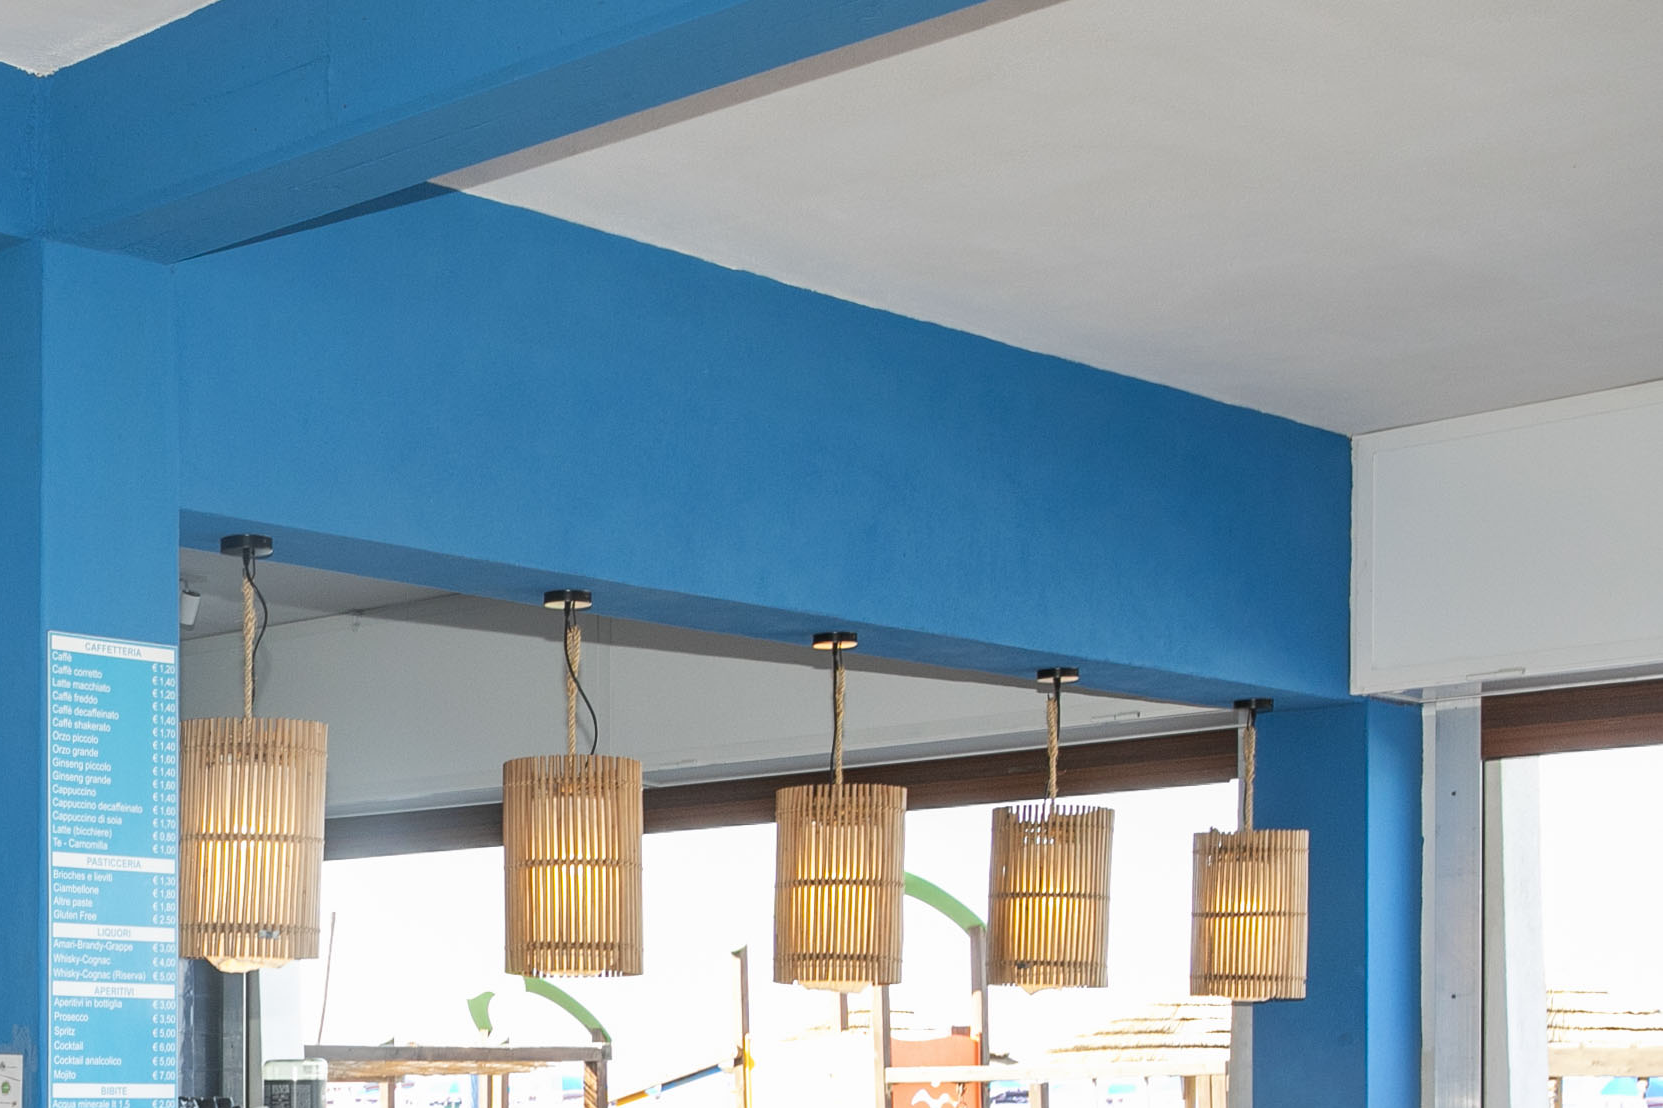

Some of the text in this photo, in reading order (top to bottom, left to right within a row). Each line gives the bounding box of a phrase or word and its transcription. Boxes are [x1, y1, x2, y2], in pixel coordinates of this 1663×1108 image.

[85, 642, 141, 657] CAFFETTERIA
[52, 651, 71, 662] Caffè
[52, 664, 72, 675] Caffè
[52, 677, 71, 688] Latte
[52, 690, 72, 701] Caffè
[73, 693, 97, 704] freddo
[52, 704, 72, 714] Caffè
[52, 717, 72, 728] Caffè
[74, 720, 110, 732] shakerato
[52, 730, 70, 741] Orzo
[72, 733, 98, 744] piccolo
[52, 743, 98, 757] Orzo grande
[52, 756, 111, 771] Ginseng piccolo
[52, 770, 111, 785] Ginseng grande
[52, 783, 96, 796] Cappuccino
[52, 797, 96, 809] Cappuccino
[52, 810, 96, 823] Cappuccino
[52, 824, 71, 834] Latte
[68, 838, 107, 850] Camomilla
[87, 856, 140, 867] PASTICCERIA
[53, 869, 85, 880] Brioches
[53, 909, 96, 920] Gluten Free
[97, 928, 130, 937] LIQUORI
[94, 986, 133, 995] APERITIVI
[54, 996, 83, 1007] Aperitivi
[93, 998, 122, 1010] bottiglia
[54, 1011, 88, 1021] Prosecco
[54, 1025, 74, 1037] Spritz
[53, 1040, 83, 1050] Cocktail
[53, 1055, 83, 1064] Cocktail
[85, 1056, 121, 1065] analcolico
[100, 1086, 126, 1095] BIBITE
[78, 1100, 109, 1108] minerale
